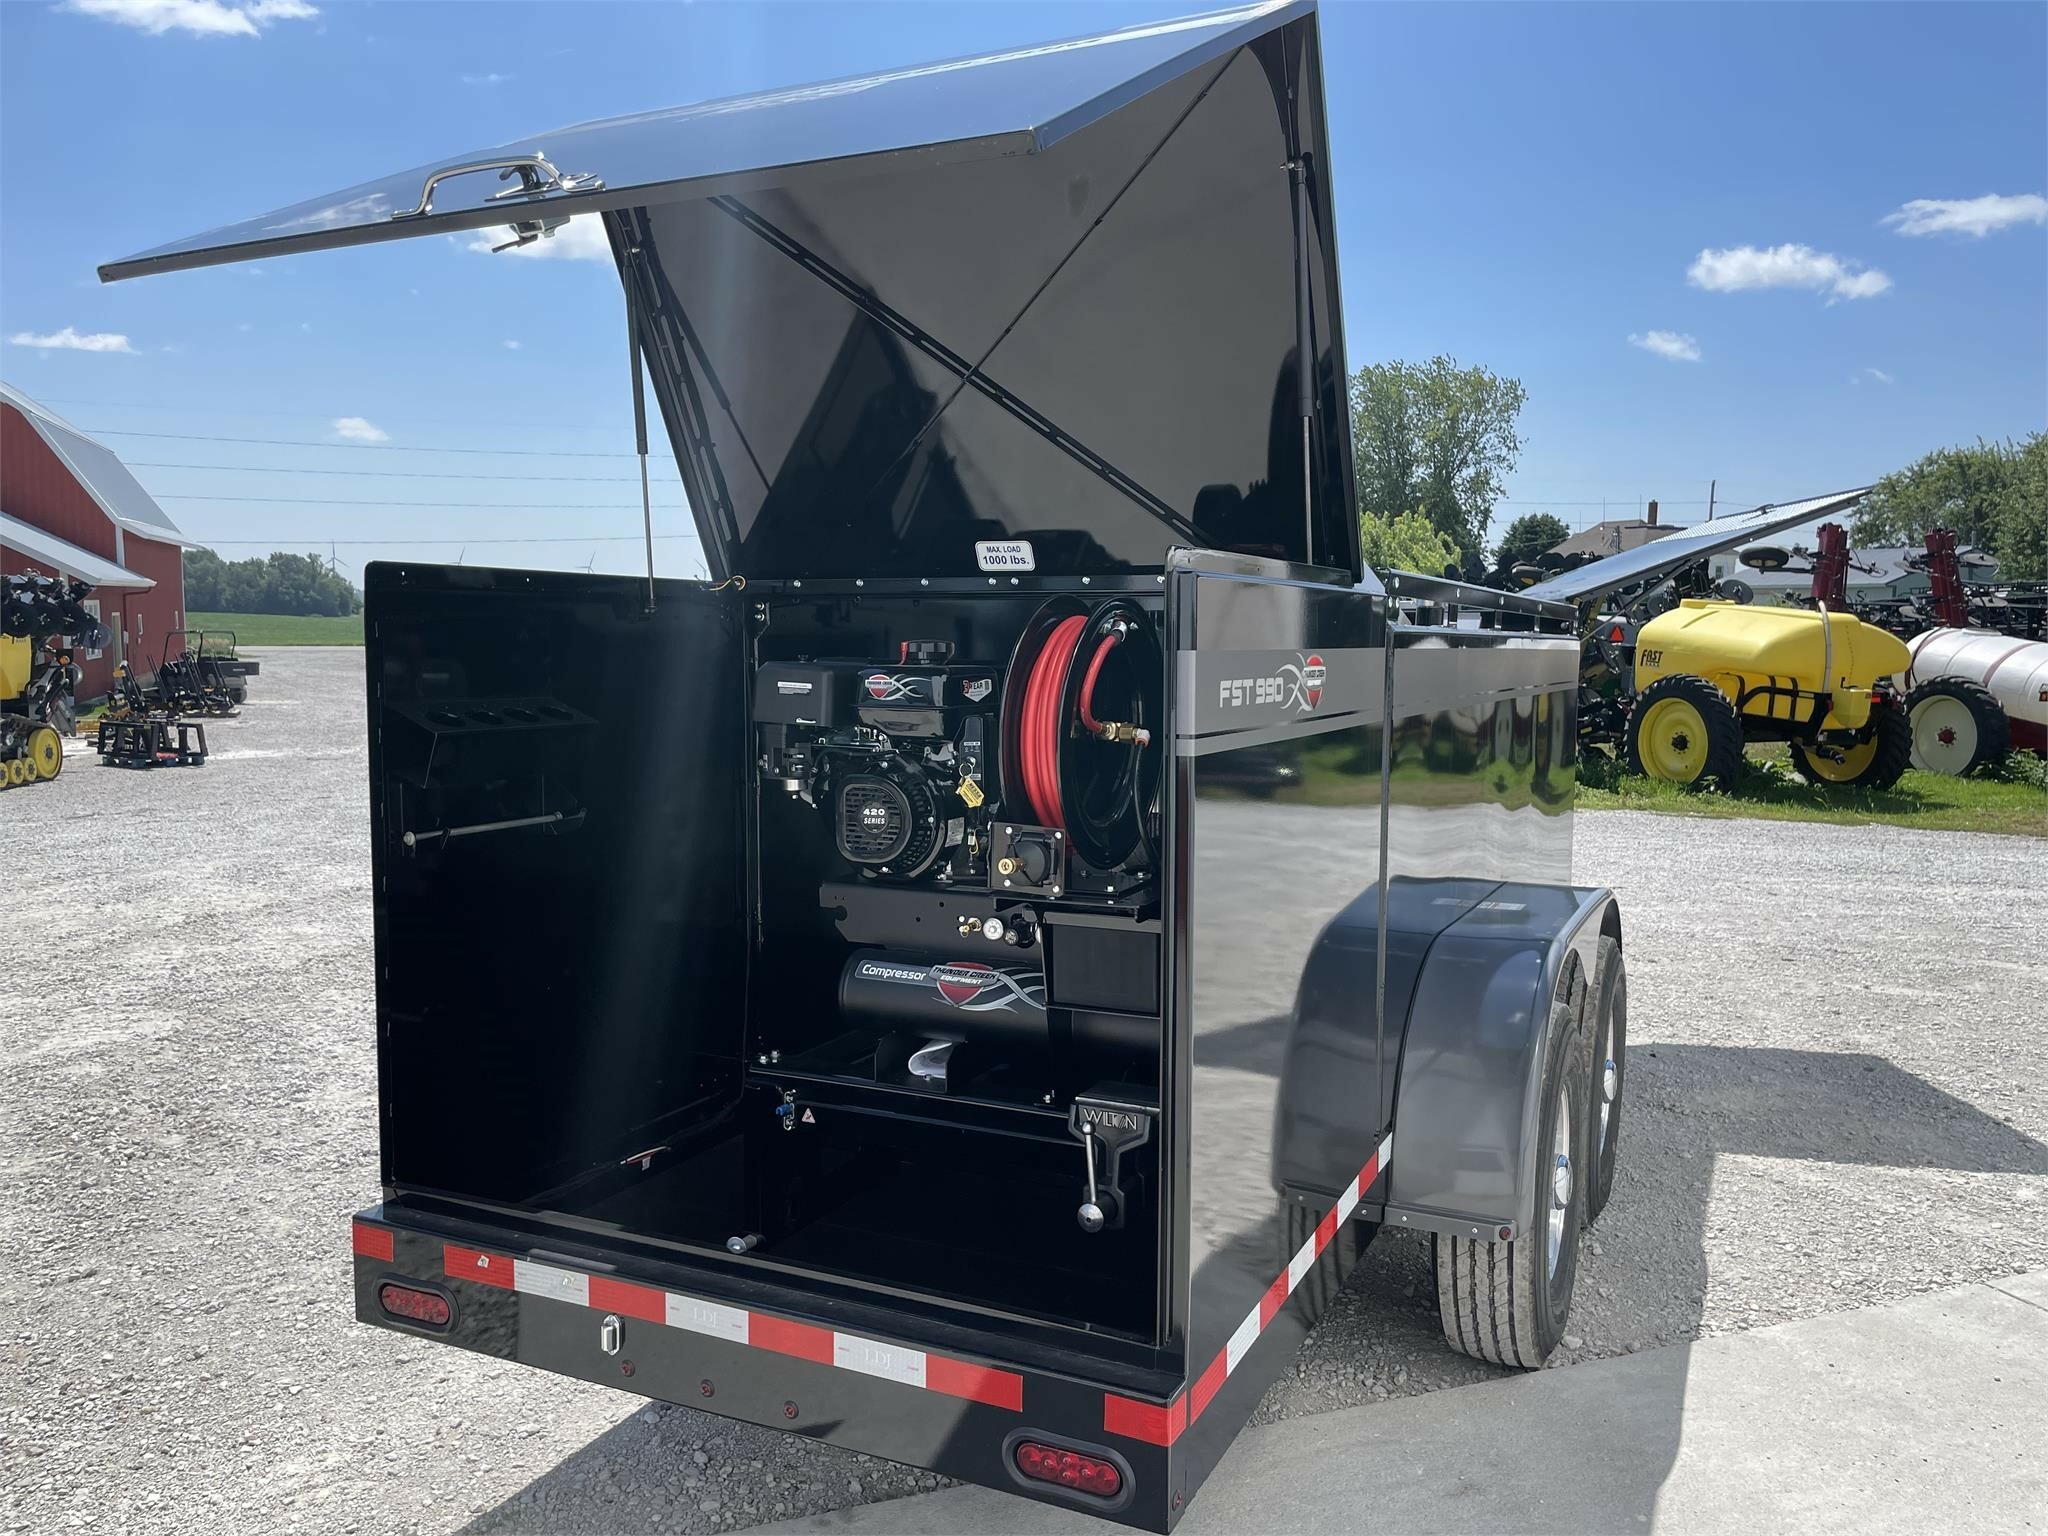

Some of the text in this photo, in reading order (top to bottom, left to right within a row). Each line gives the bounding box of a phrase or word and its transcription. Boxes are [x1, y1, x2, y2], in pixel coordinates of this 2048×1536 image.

[983, 556, 1030, 565] 1000 lbs.
[1640, 649, 1663, 666] FAST
[1219, 678, 1254, 708] FST
[863, 808, 886, 816] 420
[863, 817, 886, 825] SERIES
[861, 964, 927, 981] Compressor
[933, 966, 998, 980] THUNDER CREEK
[940, 975, 983, 985] EQUIPMENT
